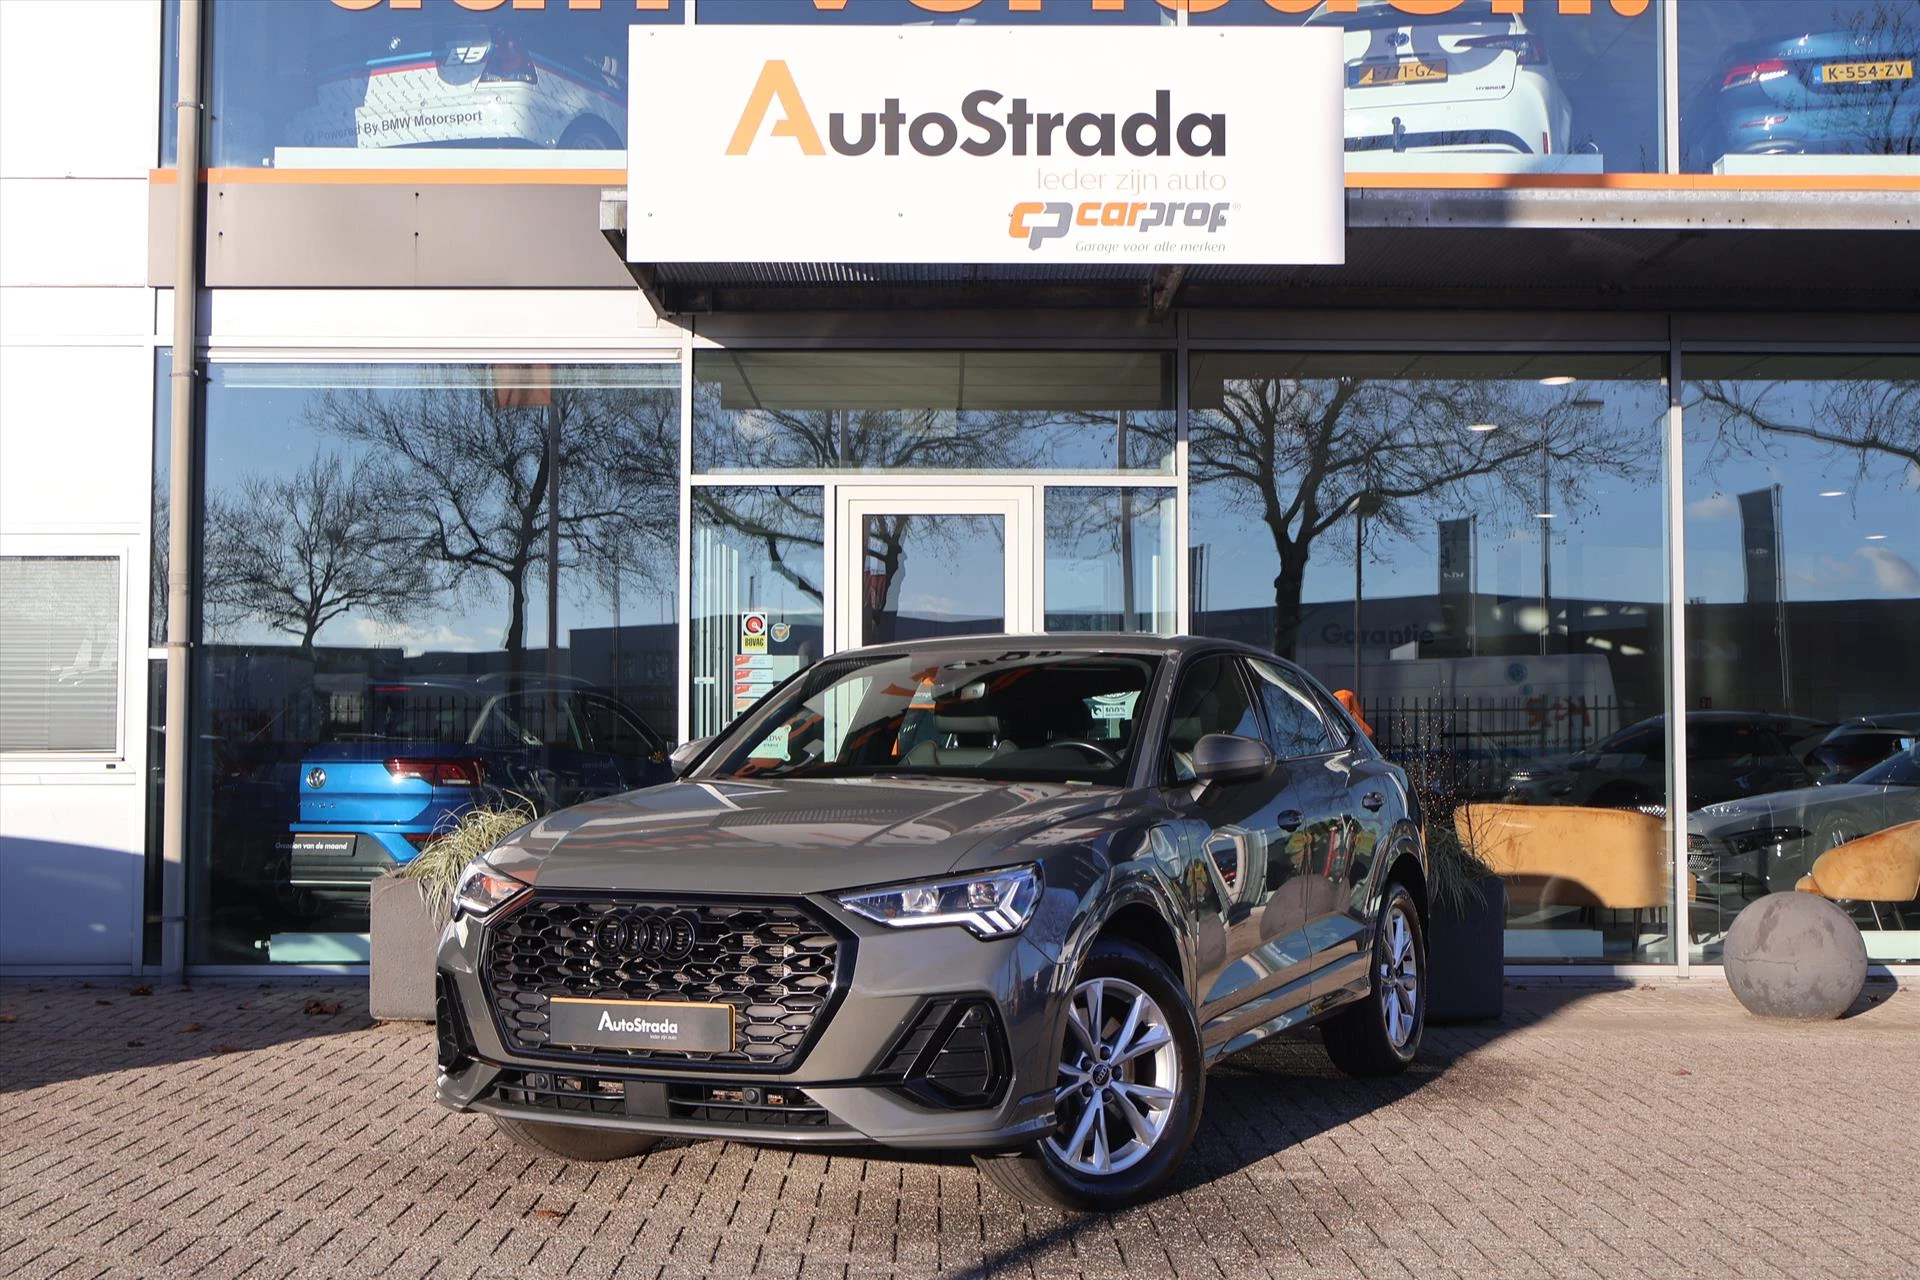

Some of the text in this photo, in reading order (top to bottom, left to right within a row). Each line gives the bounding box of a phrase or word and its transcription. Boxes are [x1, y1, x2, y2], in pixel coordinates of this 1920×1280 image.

[1828, 64, 1905, 80] K-554-ZV
[724, 58, 1227, 157] AutoStrada
[363, 122, 378, 138] By
[381, 117, 411, 132] BMW
[414, 110, 483, 127] Motorsport
[1037, 168, 1227, 196] Ieder zijn auto
[1075, 240, 1226, 254] Garage voor alle merken
[744, 637, 764, 647] BOVAG
[1321, 622, 1434, 645] Garantie
[315, 842, 323, 850] de
[325, 842, 348, 850] maand
[598, 1010, 678, 1034] AutoStrada
